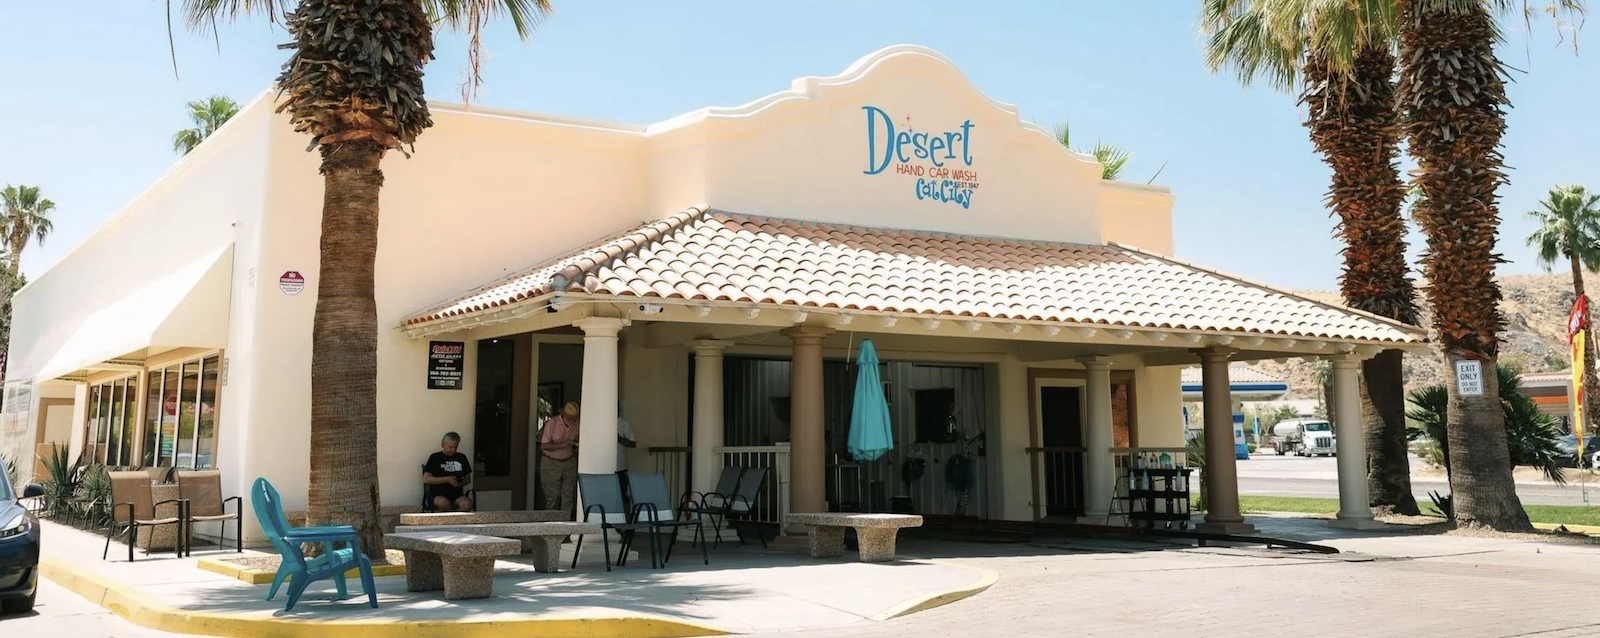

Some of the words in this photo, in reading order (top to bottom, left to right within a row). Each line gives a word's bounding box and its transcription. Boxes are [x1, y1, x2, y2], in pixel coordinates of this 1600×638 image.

[862, 106, 975, 175] Desert
[896, 163, 925, 177] HAND
[928, 166, 950, 179] CAR
[952, 168, 978, 182] WASH
